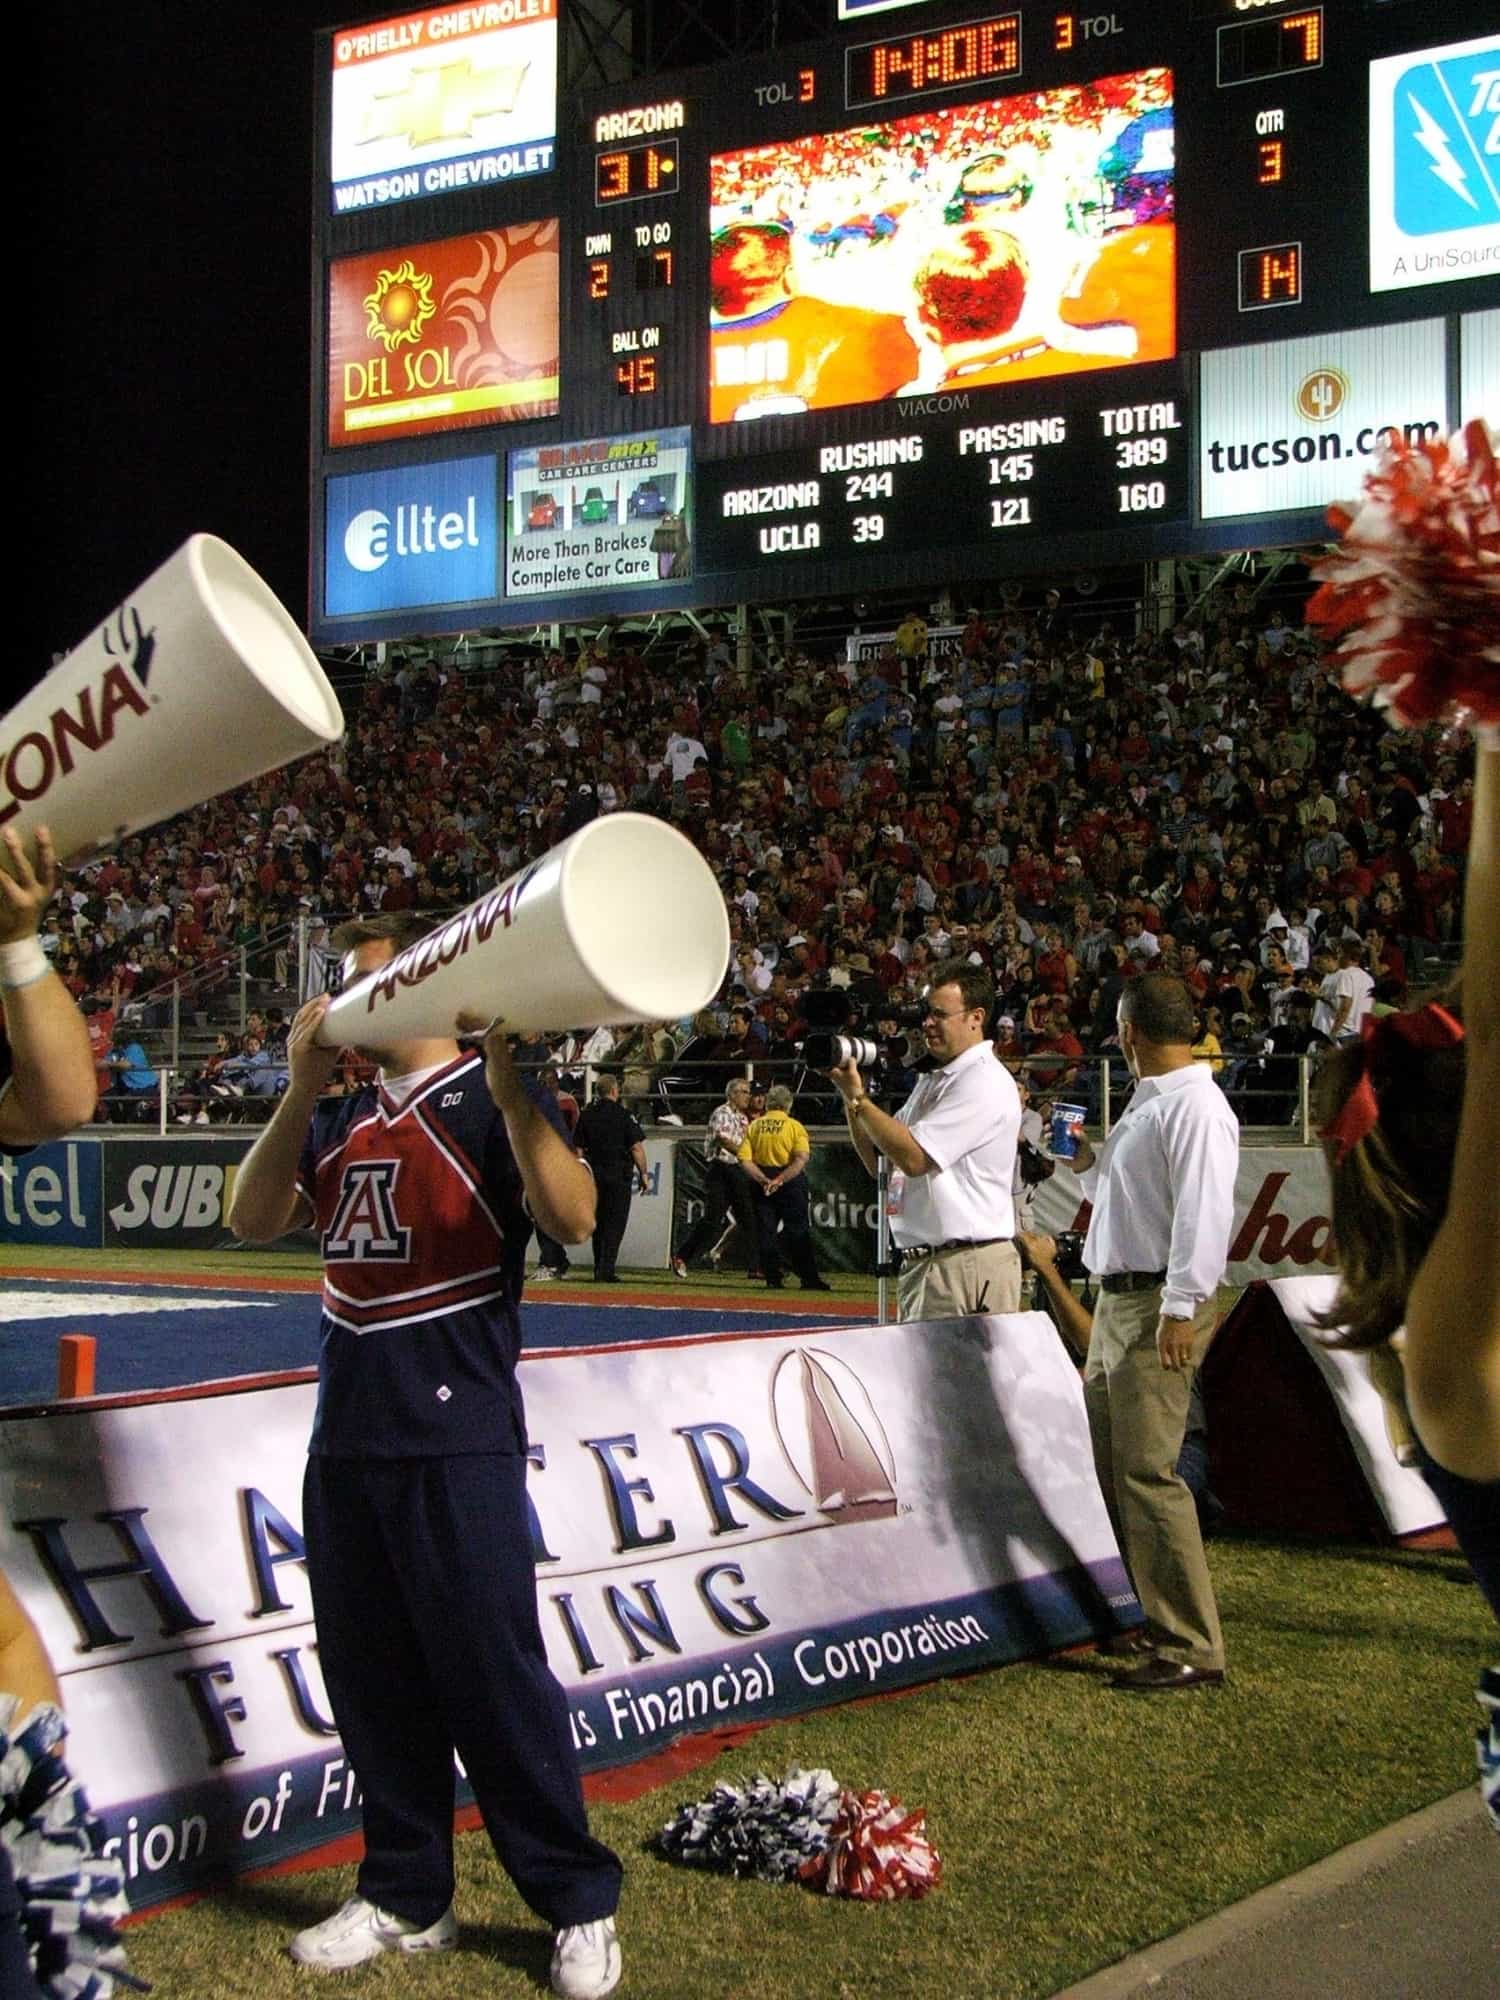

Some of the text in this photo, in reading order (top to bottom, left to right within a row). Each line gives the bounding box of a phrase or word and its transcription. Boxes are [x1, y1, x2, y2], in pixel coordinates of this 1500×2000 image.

[336, 0, 551, 62] O'RIELLY CHEVROLET
[1080, 13, 1124, 41] TOL
[1283, 15, 1319, 61] 7
[873, 18, 1017, 96] 14:06
[754, 83, 793, 107] TOL
[596, 101, 684, 142] ARIZONA
[1255, 109, 1285, 135] QTR
[335, 146, 553, 211] WATSON CHEVROLET
[1259, 141, 1282, 184] 3
[586, 233, 612, 257] DWN
[636, 222, 671, 247] TO GO
[590, 262, 609, 299] 2
[655, 251, 672, 286] 7
[1262, 250, 1296, 300] 14
[1393, 256, 1408, 276] A
[613, 327, 660, 353] BALL ON
[344, 347, 456, 402] DEL SOL
[617, 357, 656, 394] 45
[898, 394, 970, 418] VIACOM
[820, 402, 1181, 474] RUSHING PASSING TOTAL
[539, 456, 657, 481] CAR CARE CENTERS
[723, 438, 1168, 518] ARIZONA 244 145 389
[344, 496, 480, 572] alltel
[760, 482, 1166, 554] UCLA 39 121 160
[512, 532, 648, 563] More Than Brakes
[512, 558, 650, 588] Complete Car Care
[367, 883, 516, 1013] ARIZONA
[0, 1143, 87, 1228] tel
[321, 1159, 411, 1264] A
[241, 1771, 293, 1841] of
[604, 1652, 775, 1741] Financial
[792, 1612, 990, 1685] Corporation
